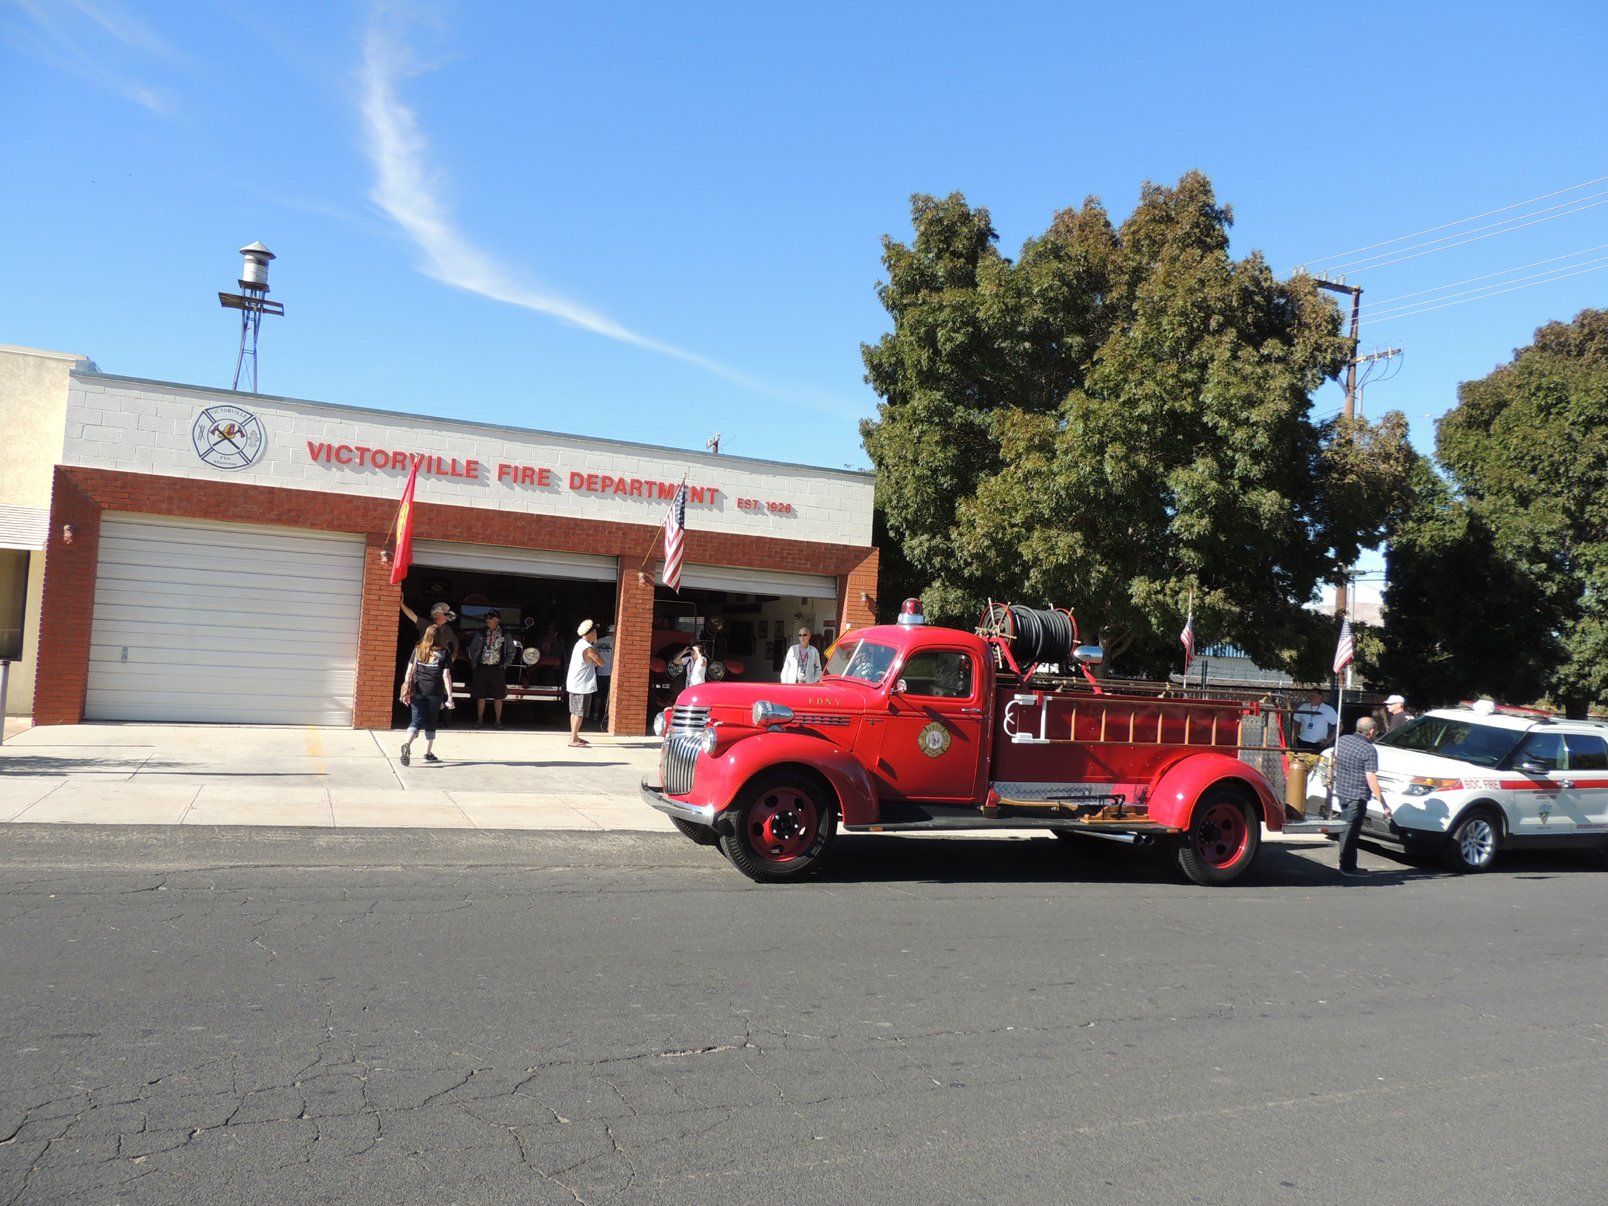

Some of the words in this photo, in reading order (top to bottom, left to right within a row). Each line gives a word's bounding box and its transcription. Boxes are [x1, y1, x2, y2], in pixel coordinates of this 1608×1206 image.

[307, 441, 479, 479] VICTORVILLE
[498, 463, 551, 487] FIRE
[1483, 780, 1500, 789] FIRE
